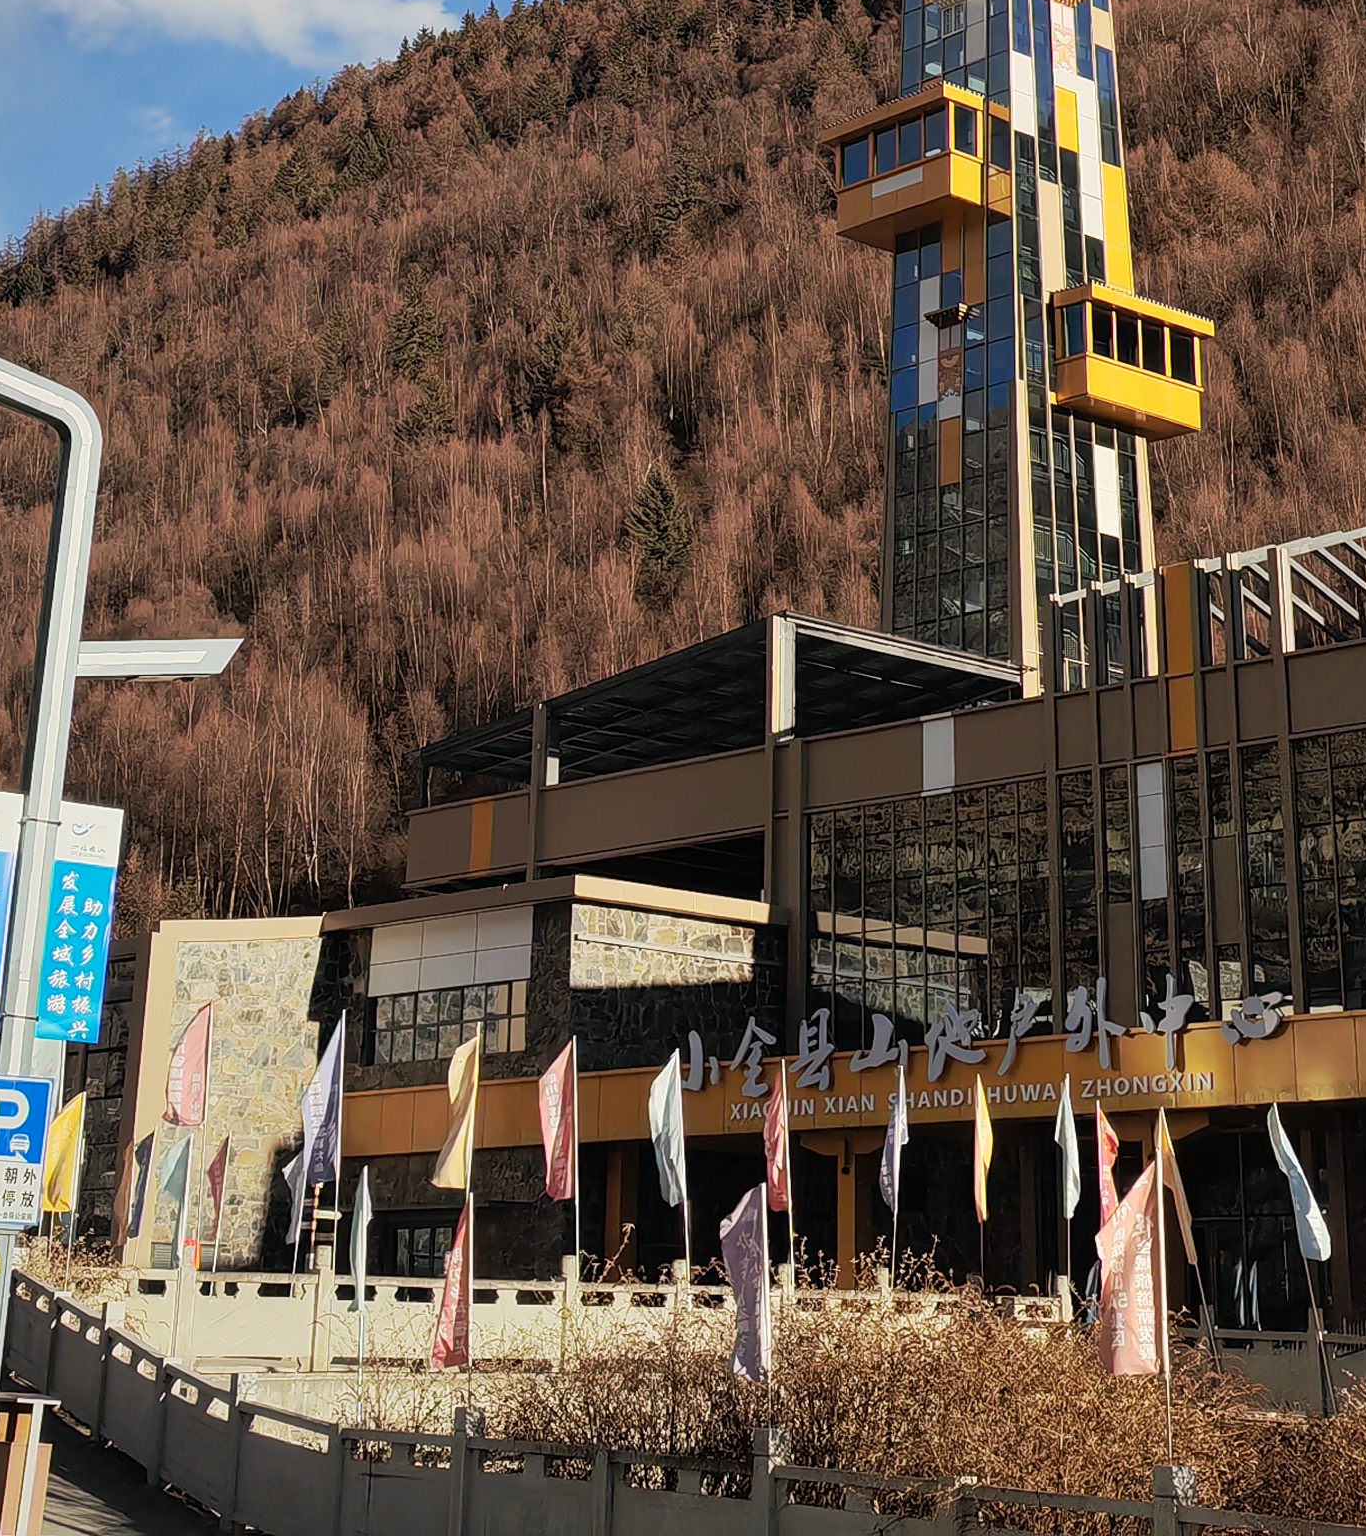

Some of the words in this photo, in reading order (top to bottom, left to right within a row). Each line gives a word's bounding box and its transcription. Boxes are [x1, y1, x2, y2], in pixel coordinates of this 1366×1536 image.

[46, 870, 79, 1015] 发展全域旅游
[67, 897, 104, 1039] 助力乡村振兴
[682, 973, 1284, 1097] 小金县山地户外中心
[824, 1094, 875, 1114] XIAN
[888, 1087, 972, 1110] SHANDI
[1081, 1071, 1214, 1099] ZHONGXIN
